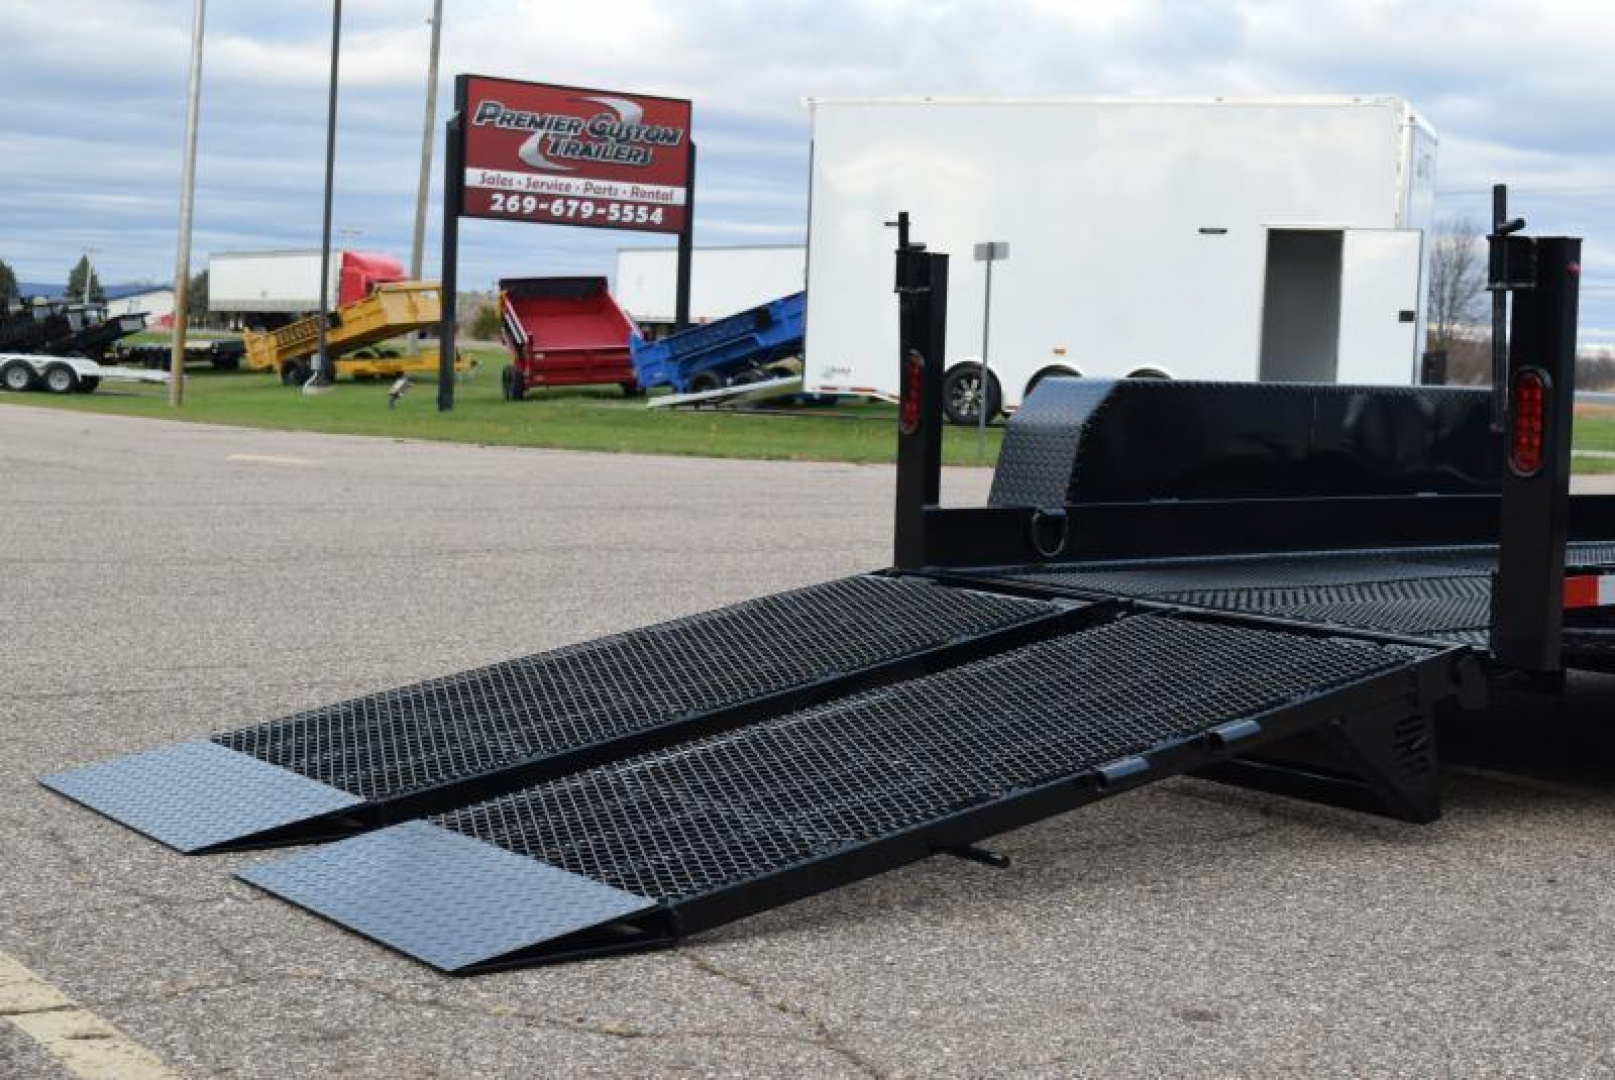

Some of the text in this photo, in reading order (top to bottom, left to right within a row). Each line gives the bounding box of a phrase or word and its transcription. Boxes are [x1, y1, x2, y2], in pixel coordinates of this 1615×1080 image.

[473, 101, 683, 146] PREMIER CUSTOM
[547, 136, 653, 166] TRAILERS
[479, 172, 675, 202] Sales Service Parts Rental
[490, 193, 663, 225] 269-679-5554
